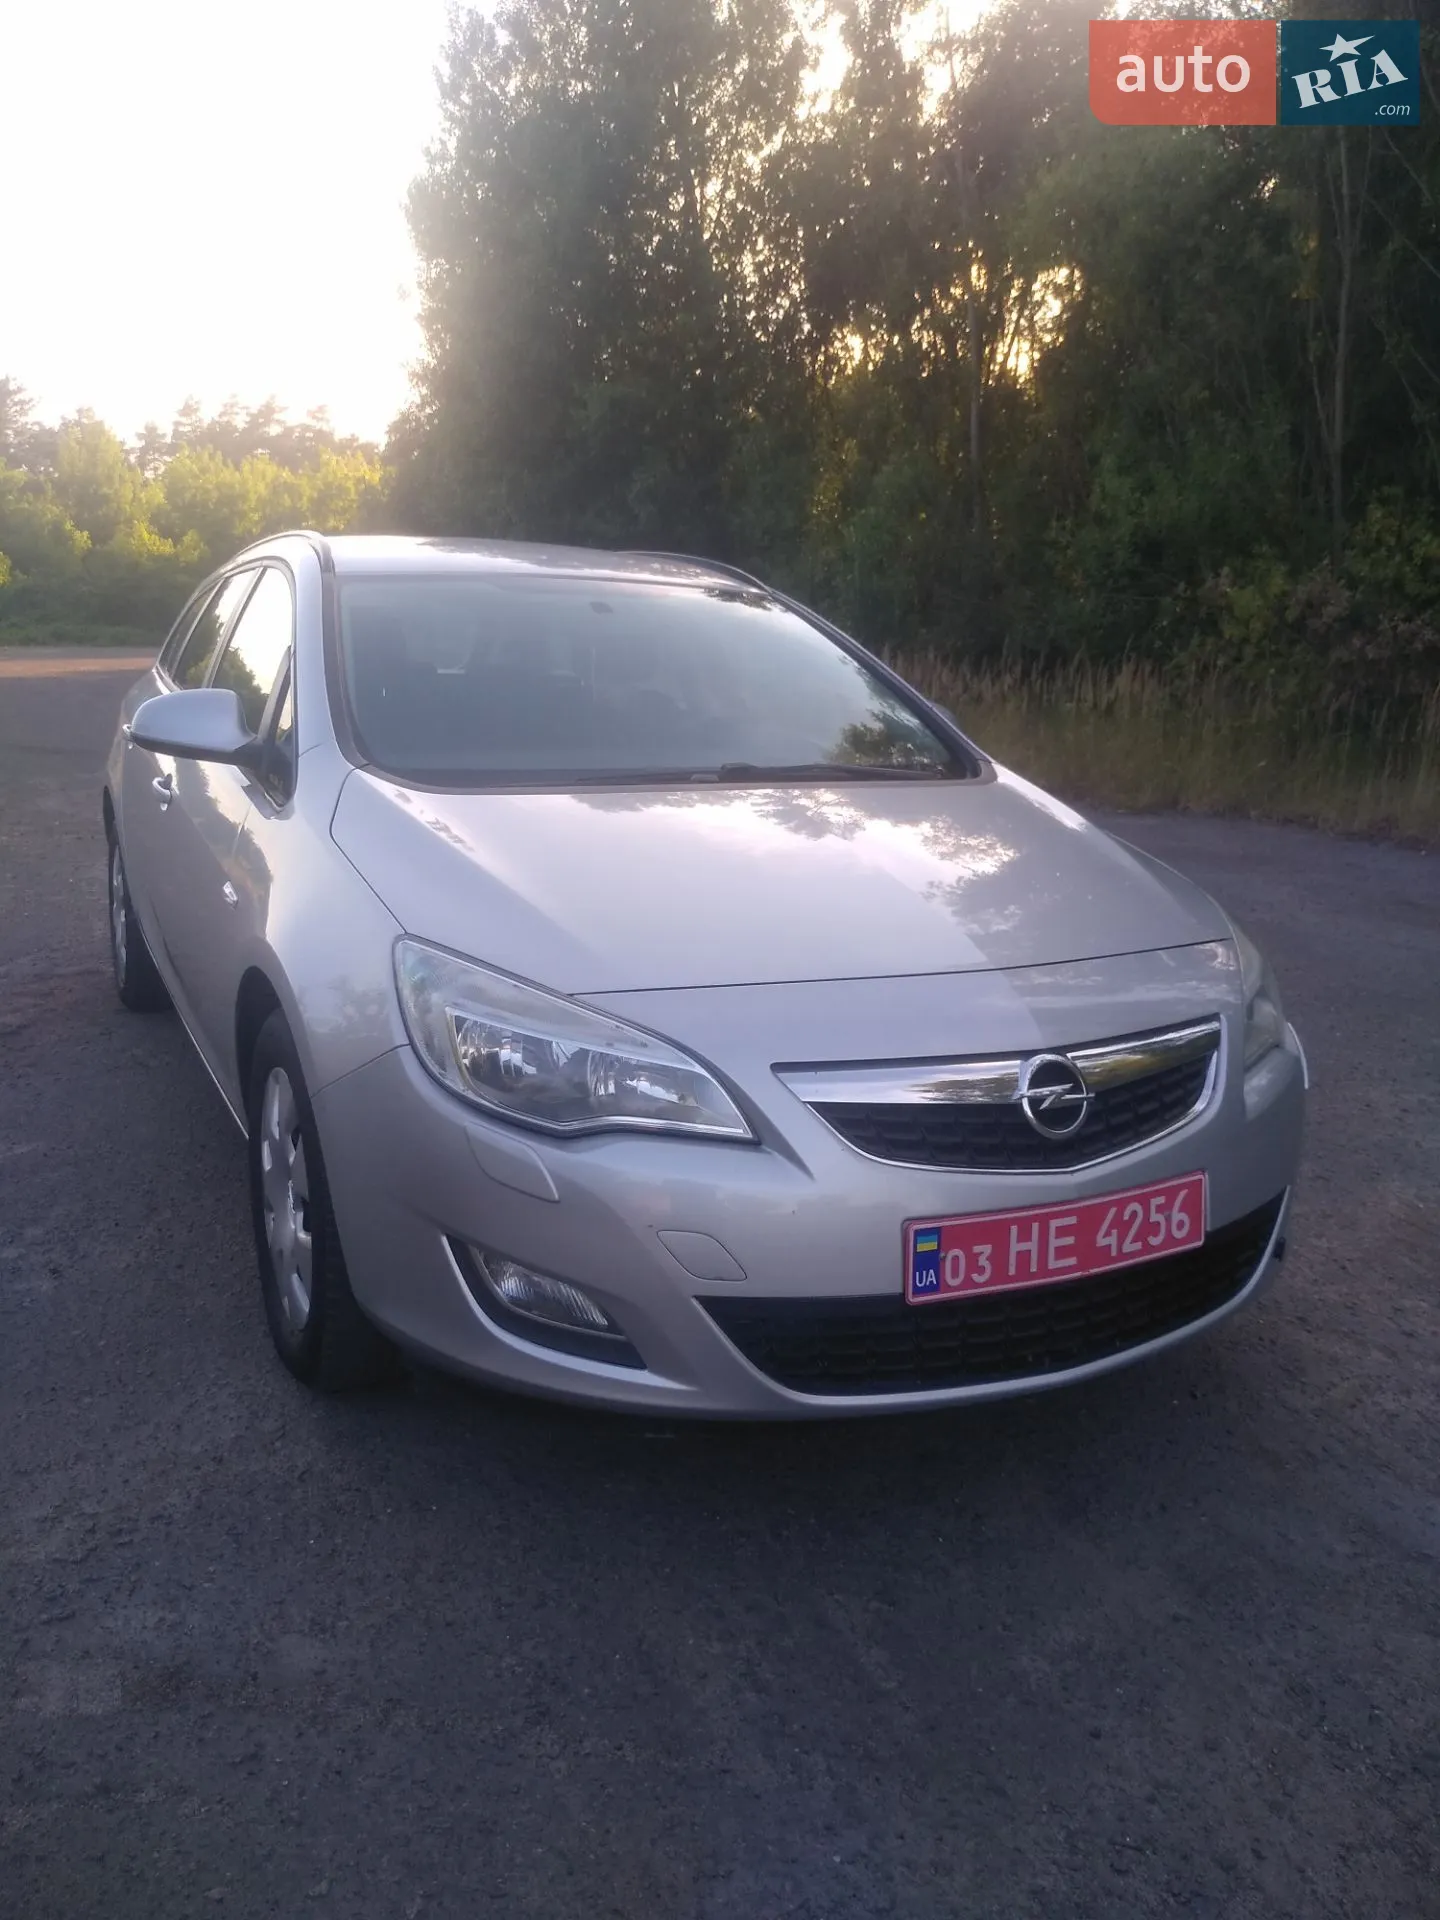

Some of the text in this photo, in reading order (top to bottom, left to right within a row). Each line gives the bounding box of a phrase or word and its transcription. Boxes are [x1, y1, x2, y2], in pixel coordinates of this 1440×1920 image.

[944, 1189, 1191, 1287] 03 HE 4256
[915, 1269, 937, 1288] UA
